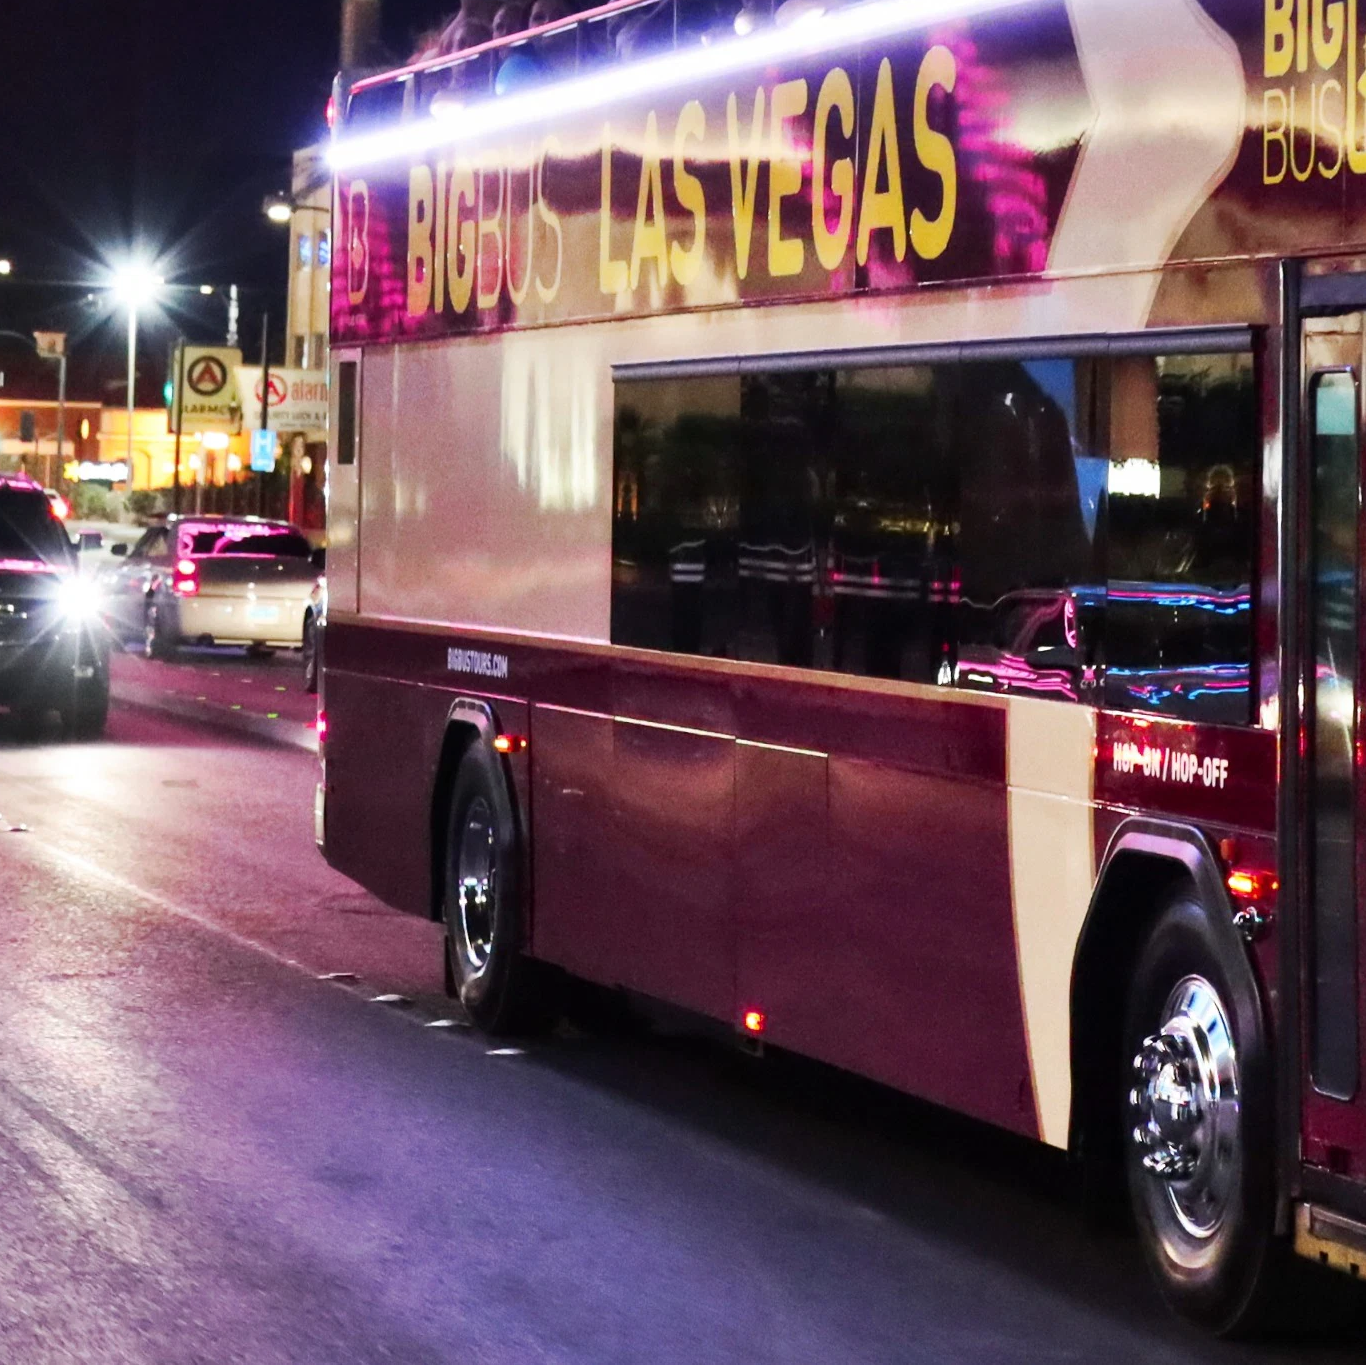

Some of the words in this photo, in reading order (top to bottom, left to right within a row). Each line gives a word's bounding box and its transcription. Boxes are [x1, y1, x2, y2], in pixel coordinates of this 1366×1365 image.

[599, 100, 707, 295] LAS
[726, 44, 958, 280] VEGAS
[1262, 78, 1342, 185] BUS
[1171, 751, 1229, 790] HOP-OFF
